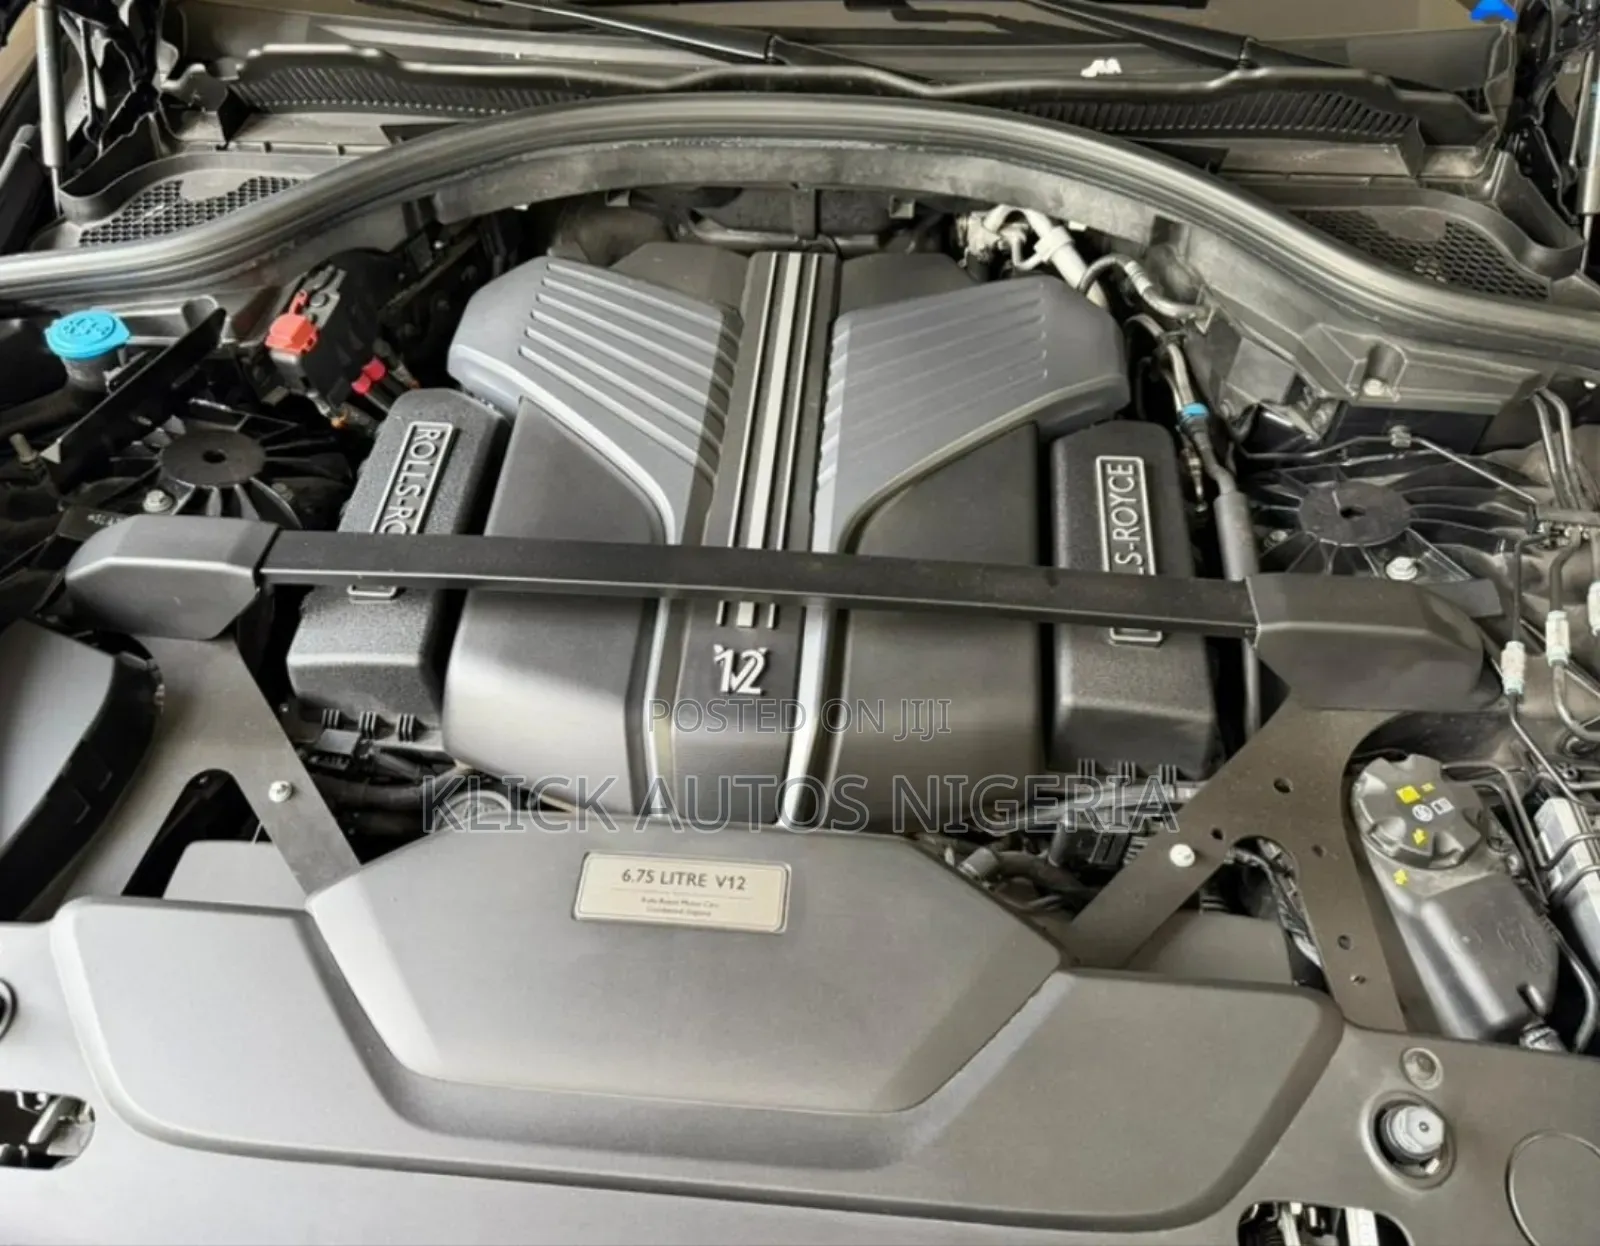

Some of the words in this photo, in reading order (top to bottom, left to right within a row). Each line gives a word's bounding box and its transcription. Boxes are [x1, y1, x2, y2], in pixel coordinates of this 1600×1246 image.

[380, 428, 441, 534] ROLLS-RO
[1106, 463, 1144, 575] S-ROYCE
[621, 869, 655, 884] 6.75
[659, 871, 708, 888] LITRE
[715, 875, 746, 891] V12
